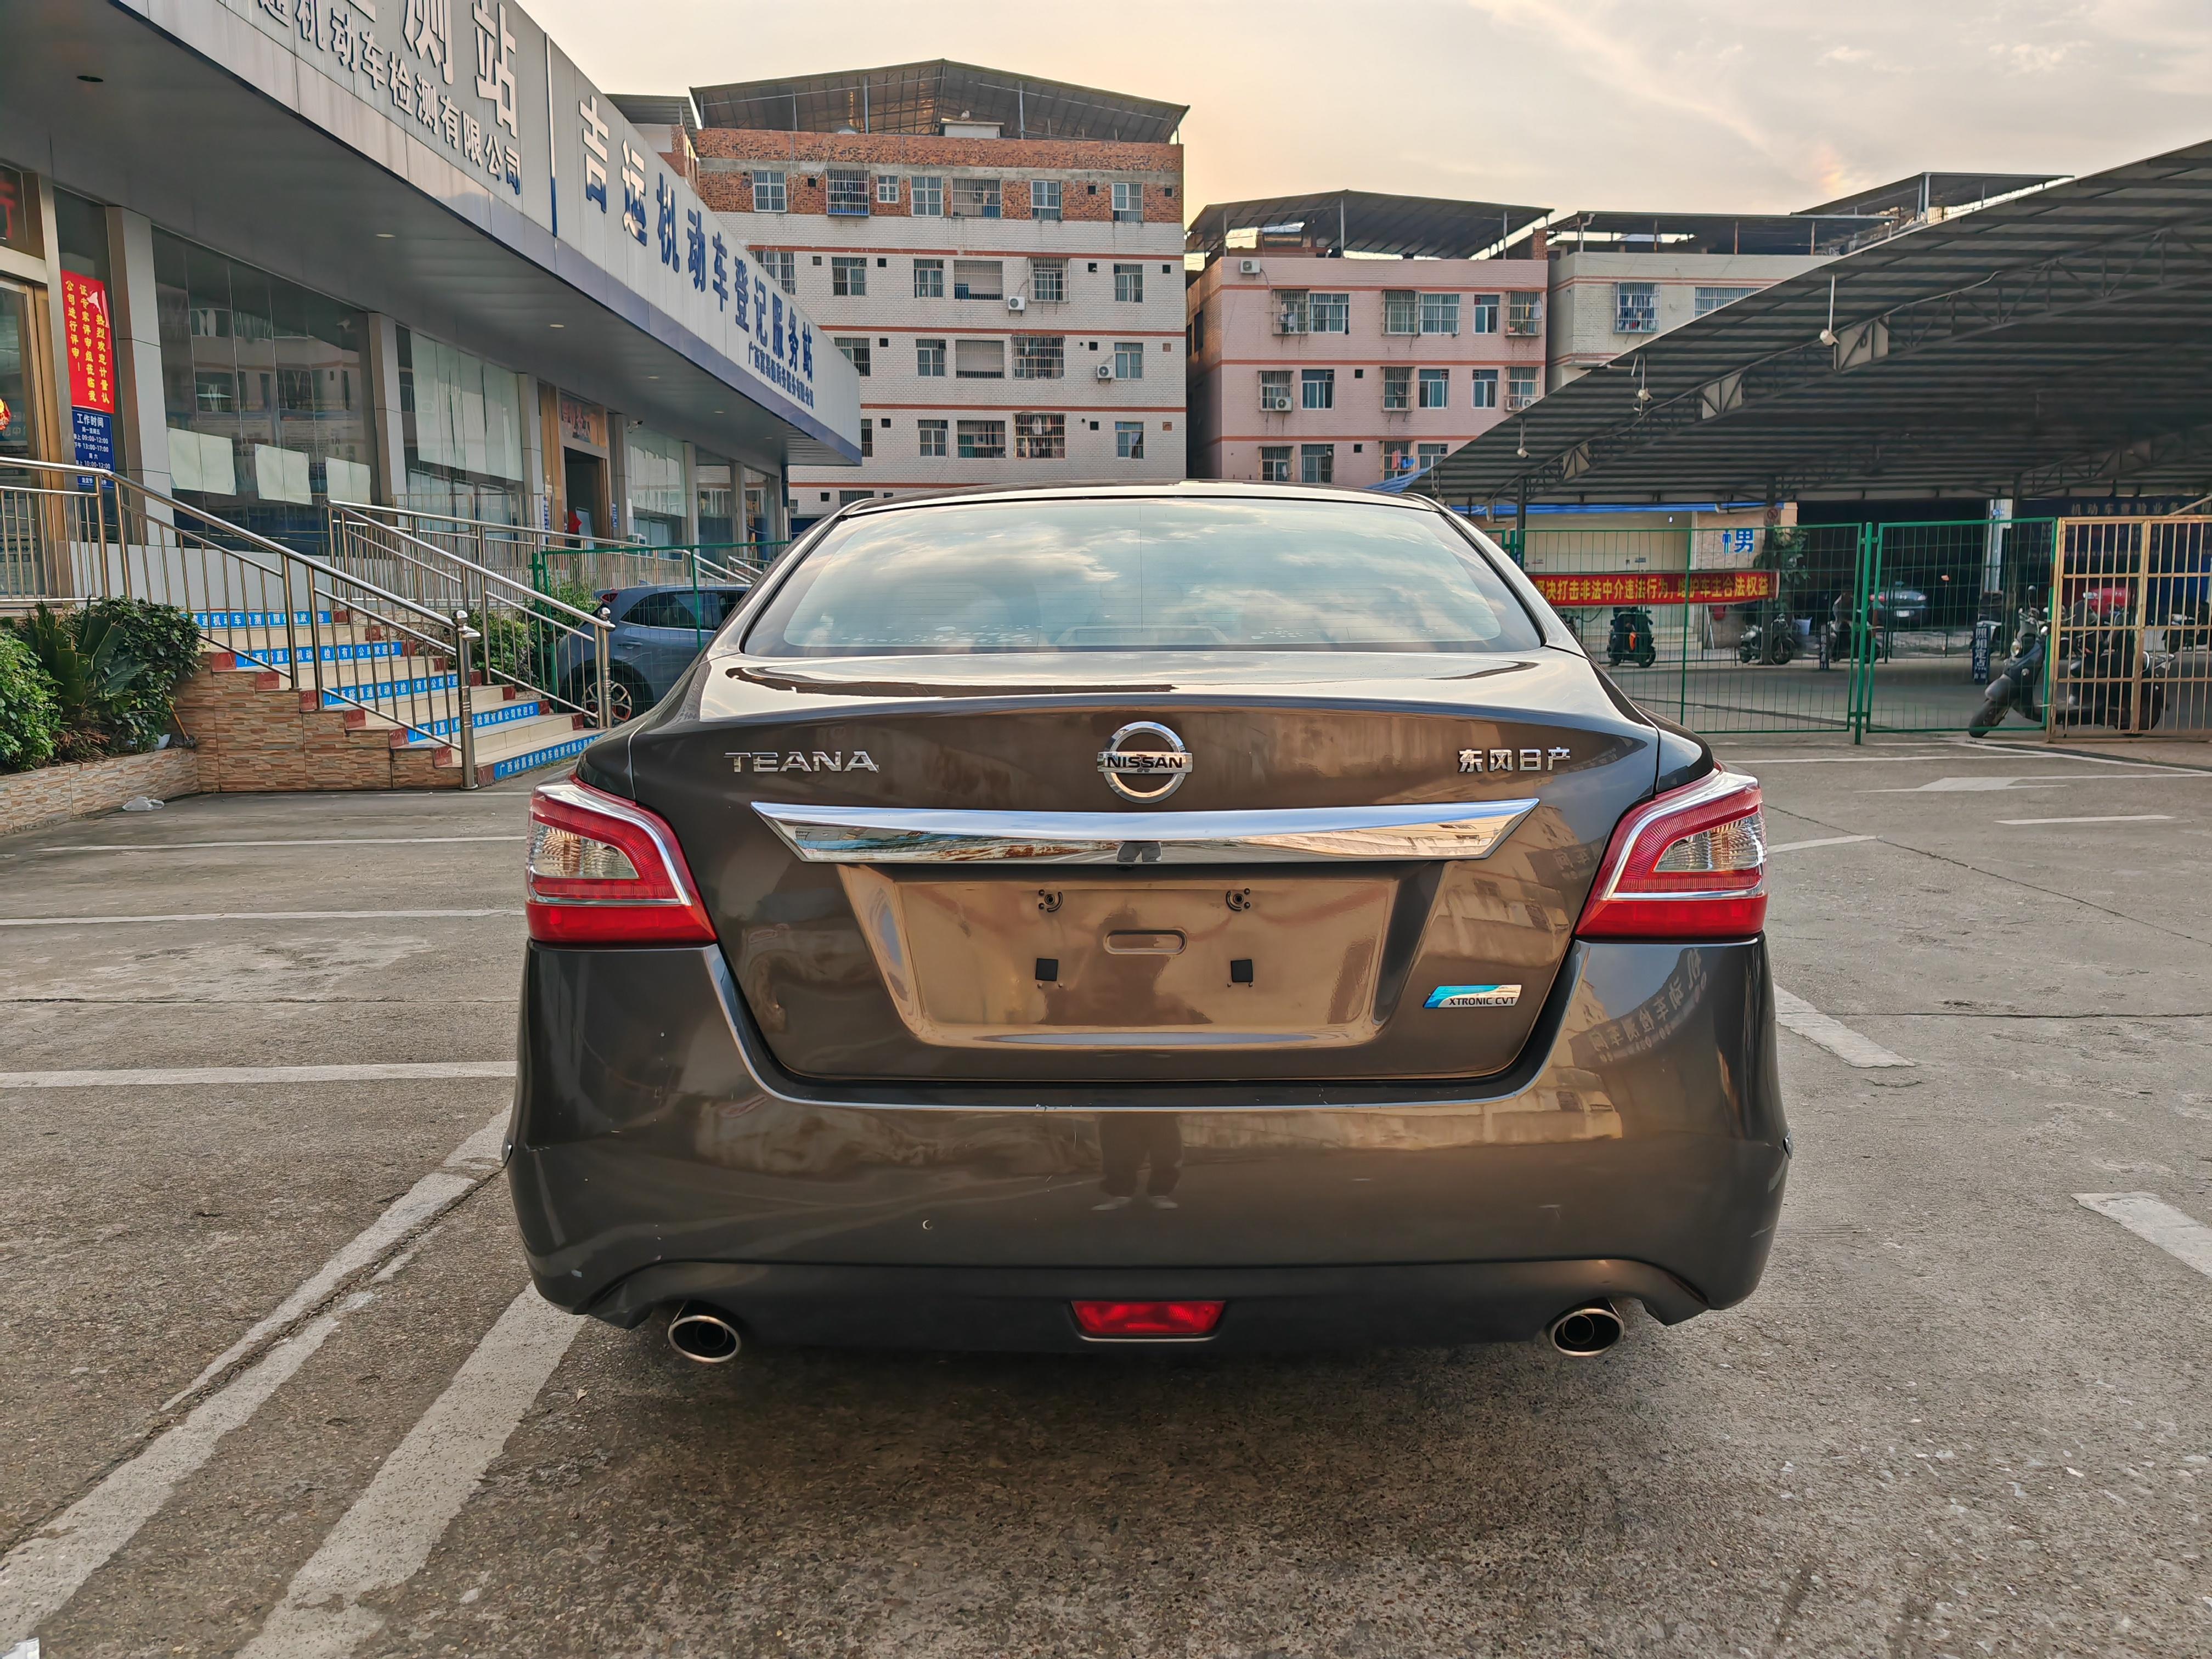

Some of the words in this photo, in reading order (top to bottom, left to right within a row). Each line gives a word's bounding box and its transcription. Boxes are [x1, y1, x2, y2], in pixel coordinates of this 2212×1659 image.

[579, 94, 813, 383] 吉运机动车登记服务站
[77, 413, 104, 428] 工作时间
[82, 434, 109, 444] 09:00-12:00
[83, 443, 109, 453] 13:00-17:00
[1734, 528, 1754, 554] 男
[724, 751, 879, 772] TEANA
[1107, 756, 1183, 769] NISSAN
[1458, 747, 1571, 772] 东风日产
[1449, 997, 1493, 1006] XTRONIC
